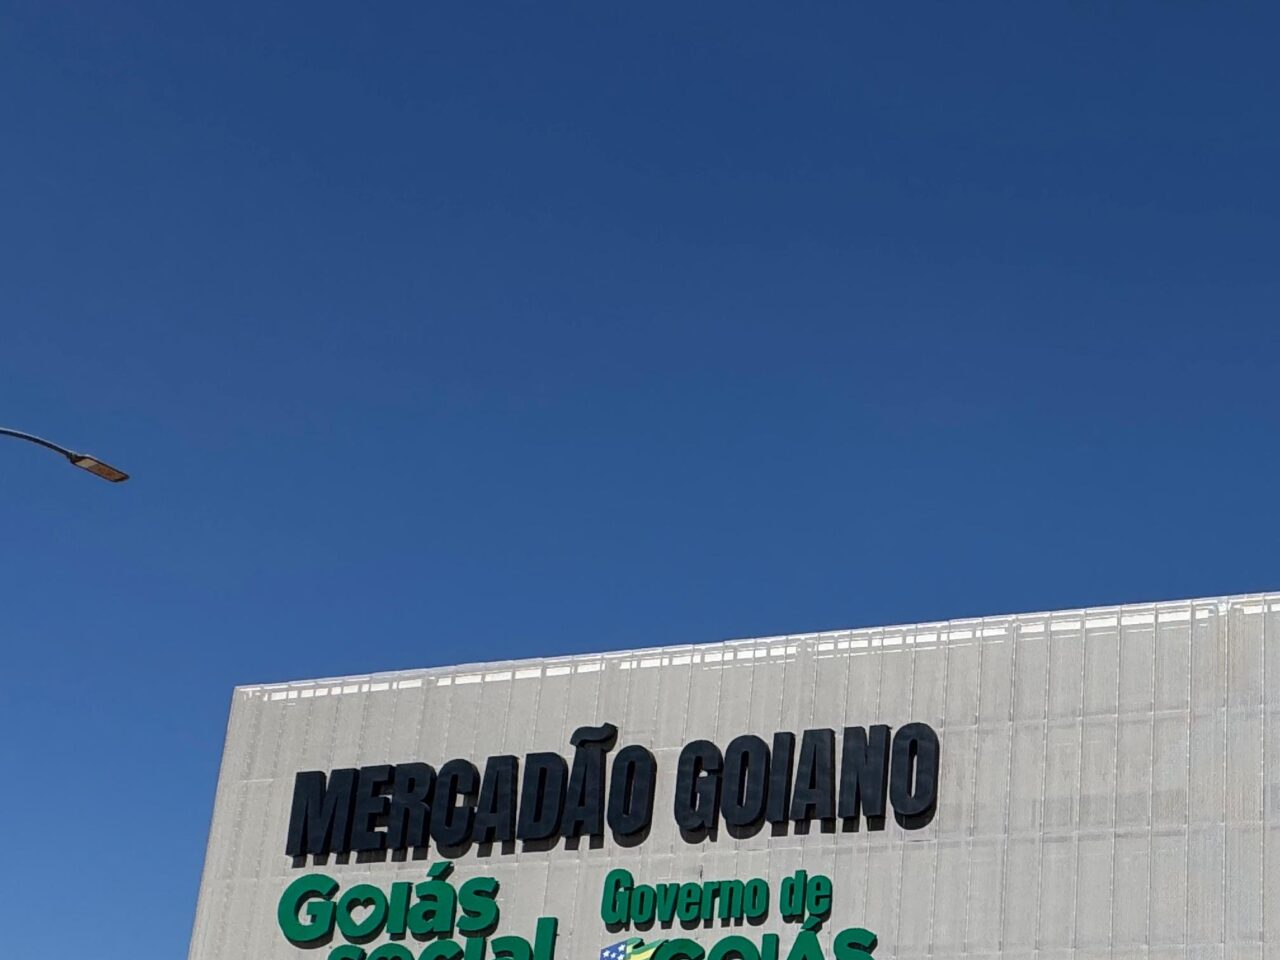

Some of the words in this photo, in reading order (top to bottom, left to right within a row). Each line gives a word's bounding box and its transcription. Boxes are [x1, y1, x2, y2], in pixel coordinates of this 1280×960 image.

[285, 721, 658, 858] MERCADÃO
[674, 721, 940, 834] GOIANO
[601, 868, 770, 928] Governo
[780, 869, 833, 919] de
